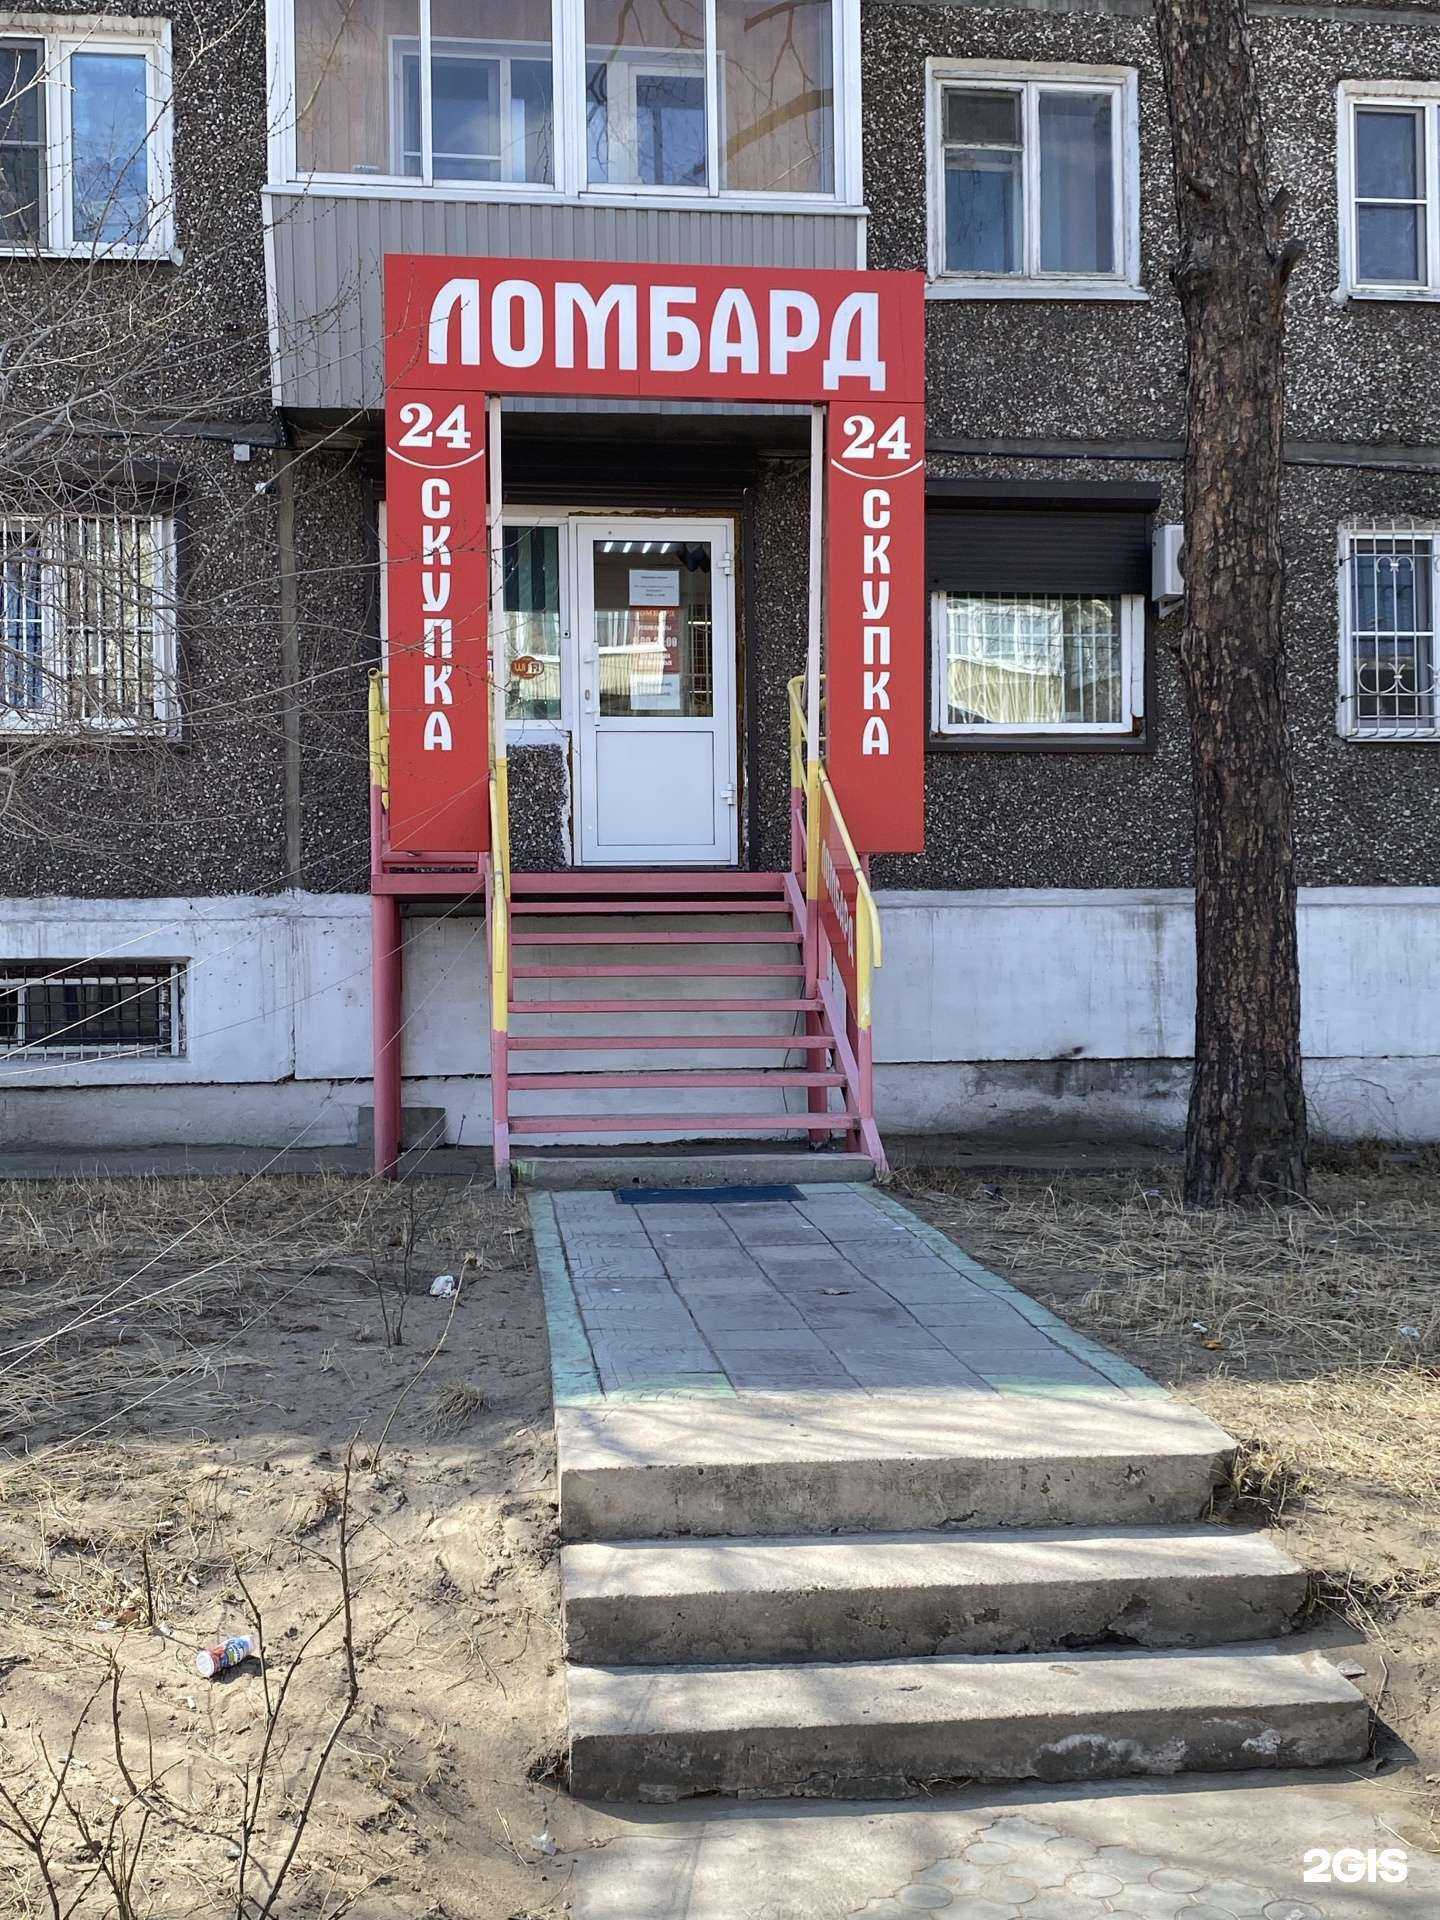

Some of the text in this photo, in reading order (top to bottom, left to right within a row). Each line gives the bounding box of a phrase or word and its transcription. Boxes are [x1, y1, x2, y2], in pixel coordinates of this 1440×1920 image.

[428, 278, 887, 392] ЛОМБАРД
[398, 402, 472, 449] 24
[841, 415, 912, 460] 24
[421, 478, 453, 751] СКУПКА
[862, 488, 891, 755] СКУПКА
